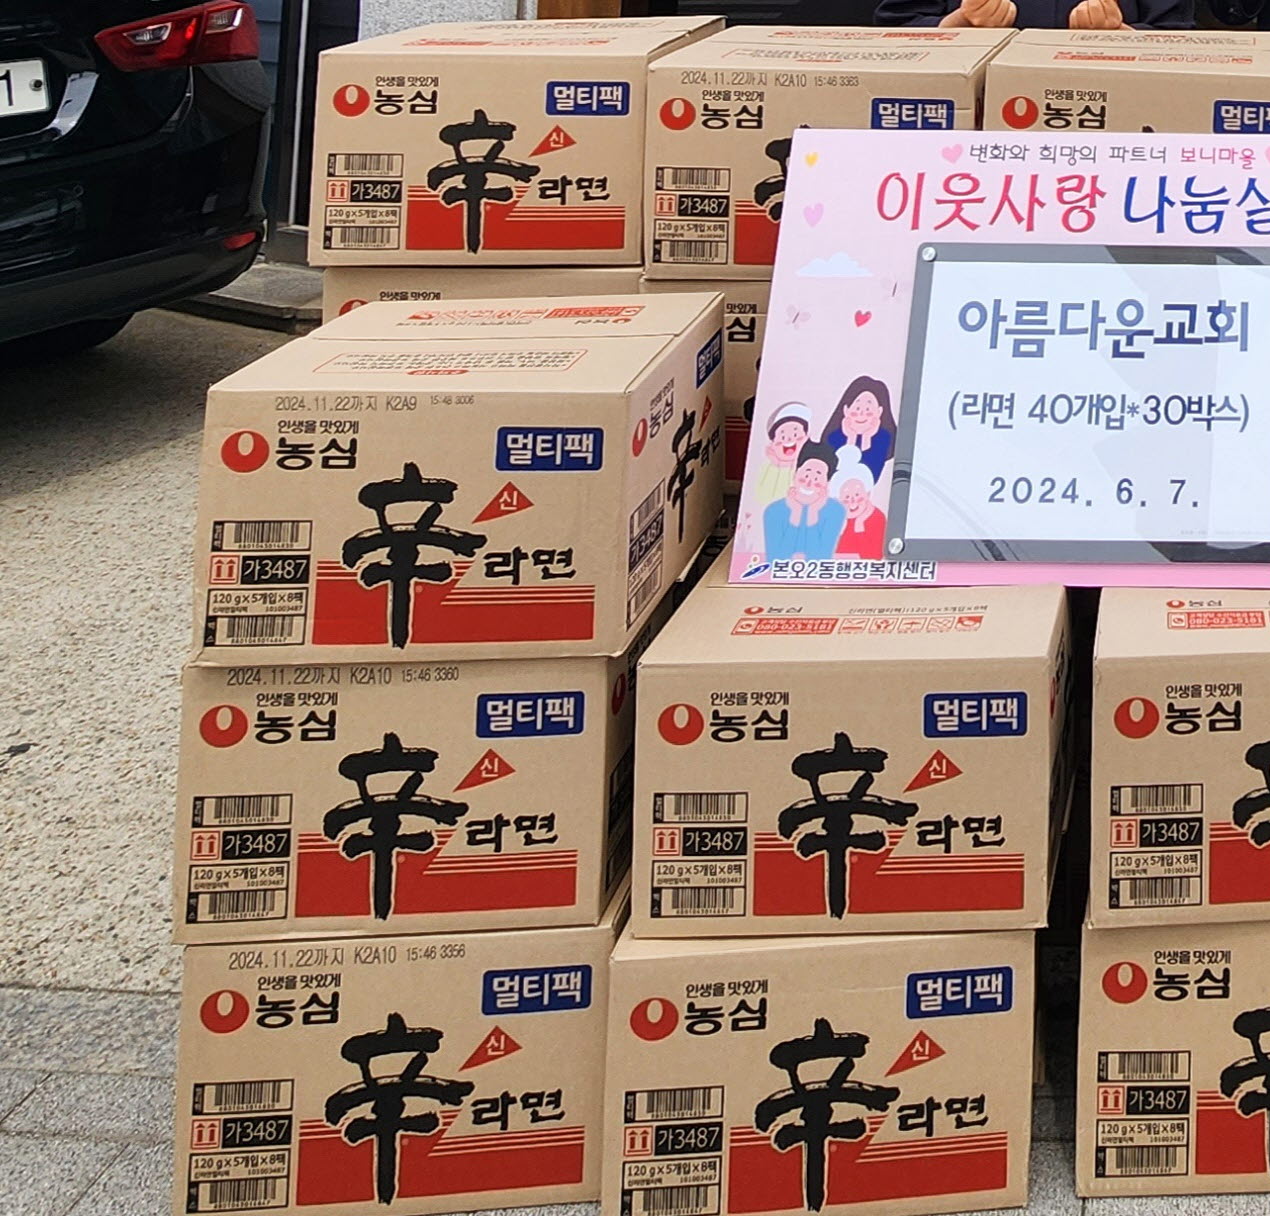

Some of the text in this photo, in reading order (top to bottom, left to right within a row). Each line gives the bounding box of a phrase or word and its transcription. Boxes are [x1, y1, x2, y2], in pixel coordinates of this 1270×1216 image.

[774, 73, 807, 87] K2A10
[373, 89, 438, 117] 농심
[553, 84, 623, 112] 멀티팩
[700, 102, 764, 132] 농심
[878, 101, 947, 130] 멀티팩
[1043, 101, 1106, 132] 농심
[970, 144, 1256, 169] 변화와 희망의 파트너 보니마을
[352, 182, 400, 201] 가3487
[425, 108, 611, 255] 辛 라면
[680, 196, 727, 216] 가3487
[876, 172, 1107, 234] 이웃사랑
[957, 298, 1249, 360] 아름다운교회
[386, 395, 417, 412] K2A9
[948, 391, 1015, 431] (라면
[274, 436, 358, 472] 농심
[506, 431, 594, 465] 멀티팩
[988, 476, 1200, 508] 2024. 6. 7.
[244, 557, 307, 582] 가3487
[338, 461, 576, 650] 辛 라면
[772, 560, 936, 581] 본오2동행정복지센터
[227, 667, 341, 687] 2024.11.22까지
[350, 667, 392, 684] K2A10
[486, 696, 574, 730] 멀티팩
[710, 691, 790, 706] 인생을 맛있게
[253, 709, 337, 745] 농심
[709, 709, 789, 743] 농심
[933, 698, 1018, 731] 멀티팩
[1164, 700, 1242, 735] 농심
[928, 758, 946, 779] 신
[320, 731, 559, 921] 辛 라면
[685, 829, 744, 853] 가3487
[778, 732, 1006, 919] 辛 라면
[1142, 820, 1200, 844] 가3487
[225, 832, 288, 856] 가3487
[229, 948, 344, 971] 2024.11.22까지
[354, 945, 396, 965] K2A10
[492, 970, 582, 1008] 멀티팩
[916, 973, 1004, 1012] 멀티팩
[1153, 967, 1230, 1001] 농심
[254, 991, 340, 1030] 농심
[684, 997, 767, 1037] 농심
[323, 1009, 565, 1208] 辛 라면
[754, 1013, 990, 1215] 辛 라면
[1129, 1088, 1187, 1111] 가3487
[225, 1117, 289, 1144] 가3487
[658, 1124, 720, 1152] 가3487
